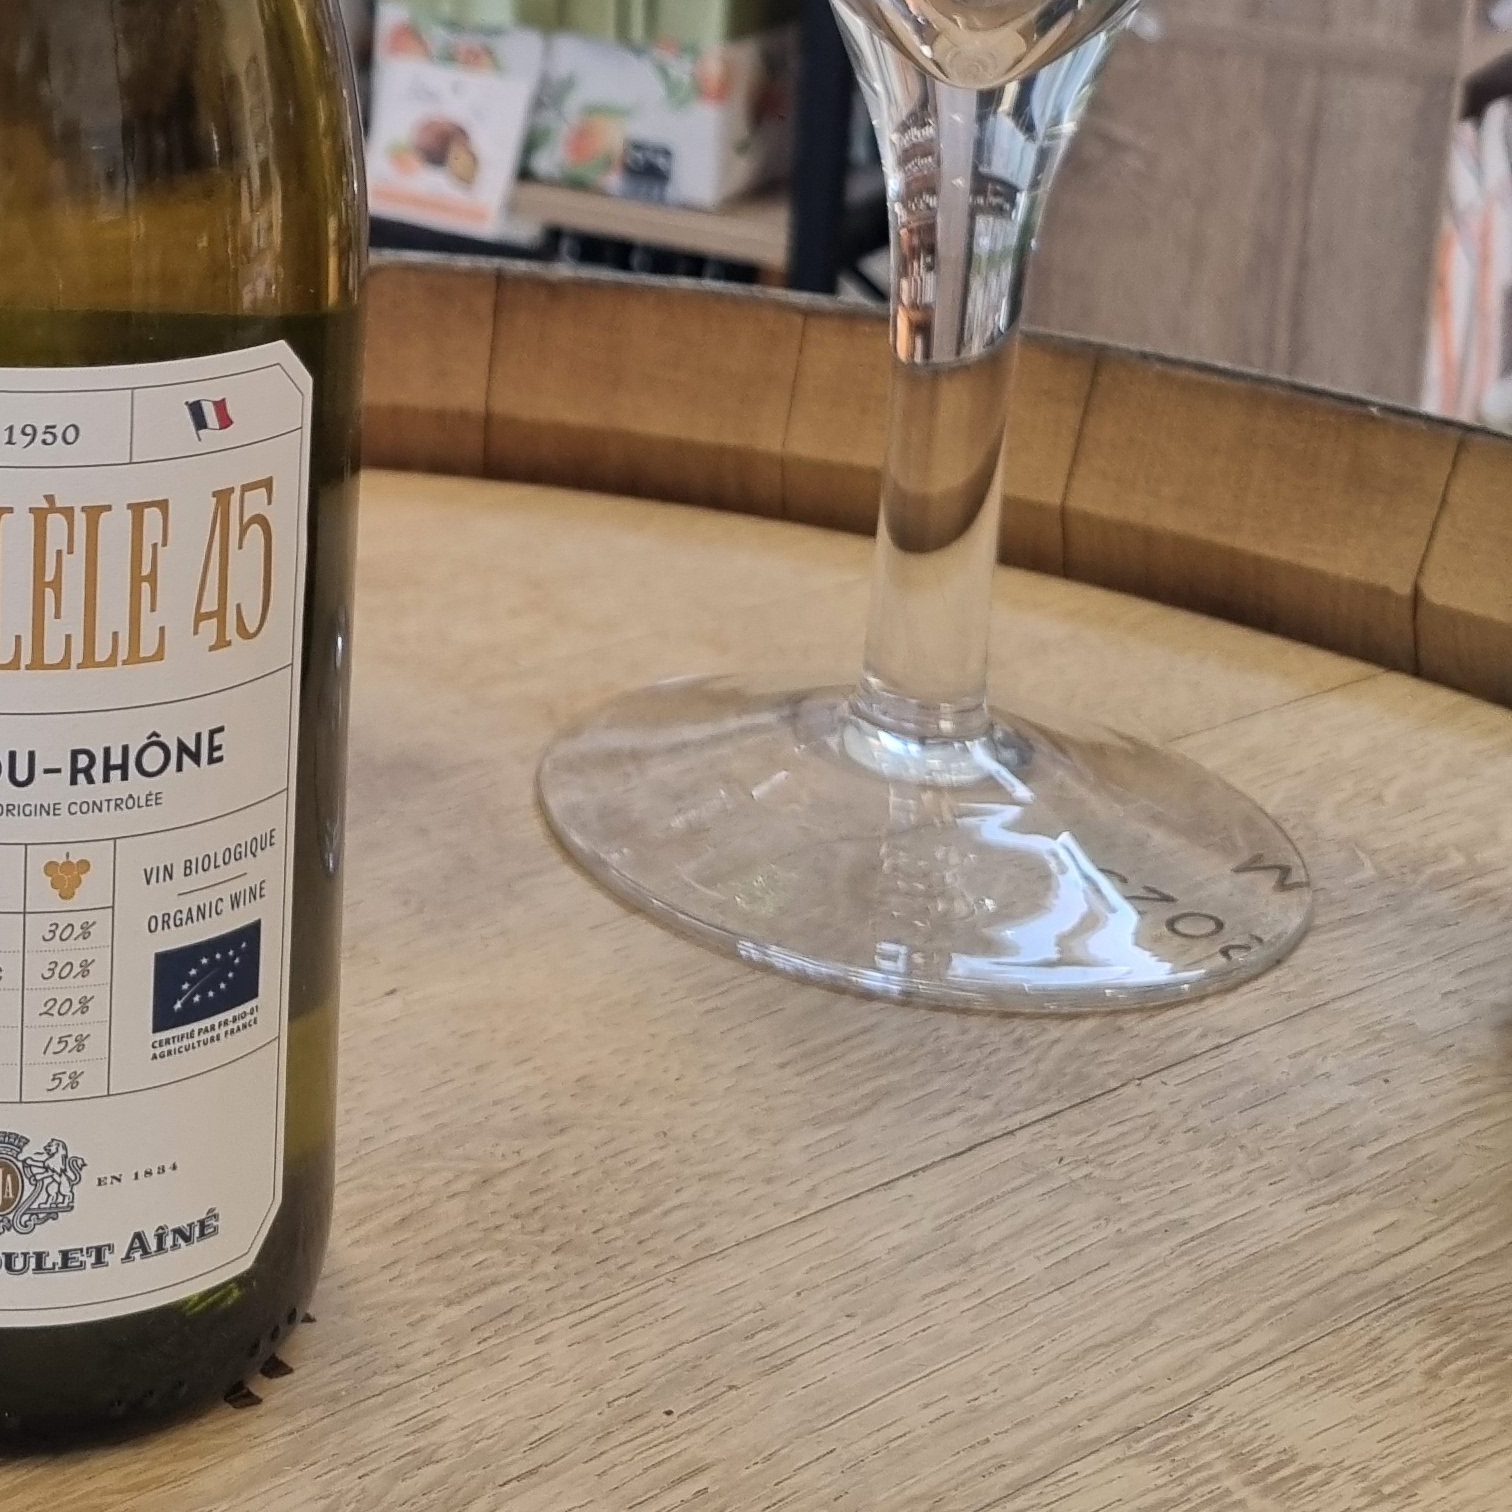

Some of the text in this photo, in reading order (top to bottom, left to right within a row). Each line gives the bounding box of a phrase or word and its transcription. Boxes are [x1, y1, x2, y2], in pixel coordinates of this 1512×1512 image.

[3, 423, 81, 449] 1950
[193, 474, 274, 654] 45
[67, 790, 164, 817] CONTRÔLÉE
[143, 828, 276, 886] VIN BIOLOGIQUE
[147, 879, 266, 934] ORGANIC WINE
[41, 919, 97, 943] 30%
[40, 957, 96, 981] 30%
[38, 994, 94, 1018] 20%
[42, 1031, 91, 1055] 15%
[150, 1016, 258, 1061] AGRICULTURE FRANCE
[151, 1028, 195, 1050] CERTIFIÉ
[197, 1022, 216, 1037] PAR
[47, 1069, 86, 1093] 5%
[96, 1173, 124, 1187] EN
[131, 1161, 180, 1182] 1834
[119, 1206, 220, 1264] AÎNÉ
